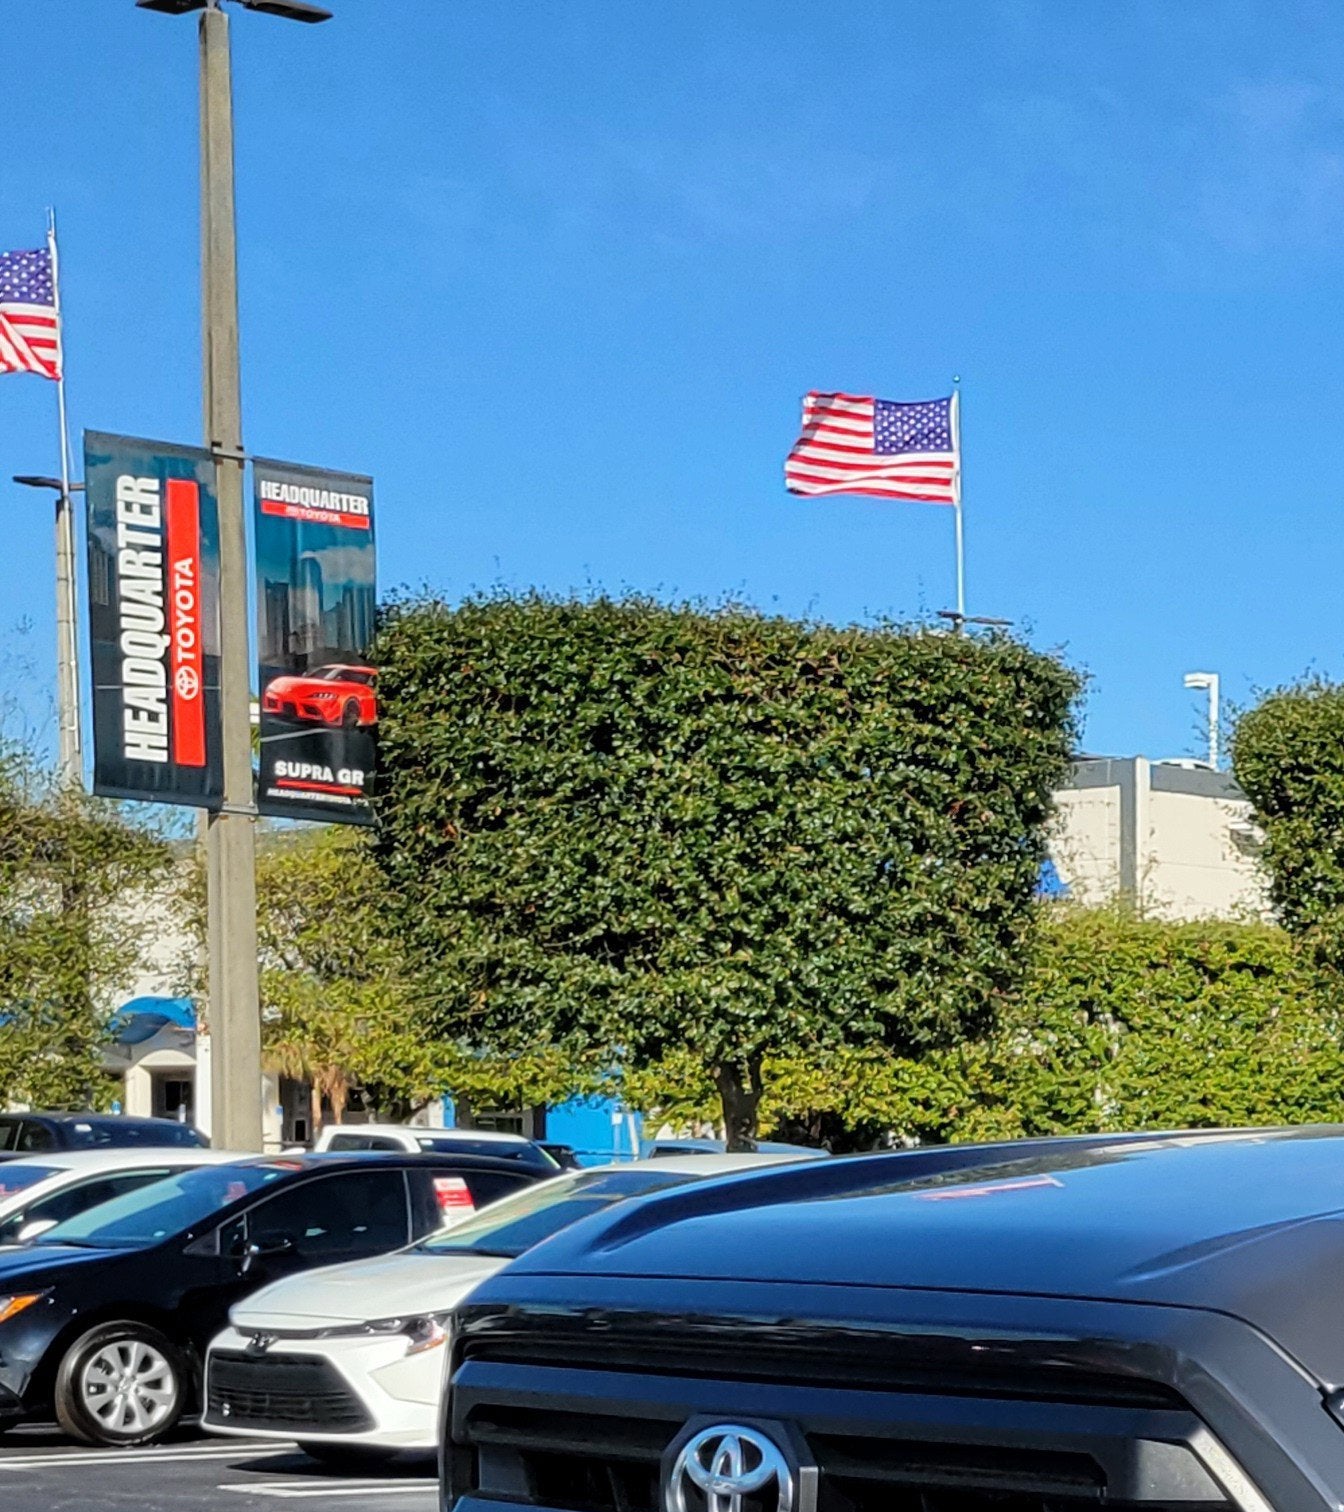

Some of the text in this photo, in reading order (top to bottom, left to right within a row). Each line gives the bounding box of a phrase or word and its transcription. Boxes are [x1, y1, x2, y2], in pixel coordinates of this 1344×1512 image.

[261, 480, 370, 516] HEADQUARTER
[299, 507, 341, 524] TOYOTA
[116, 475, 169, 763] HEADQUARTER
[174, 557, 196, 663] TOYOTA
[274, 760, 365, 786] SUPRA GR
